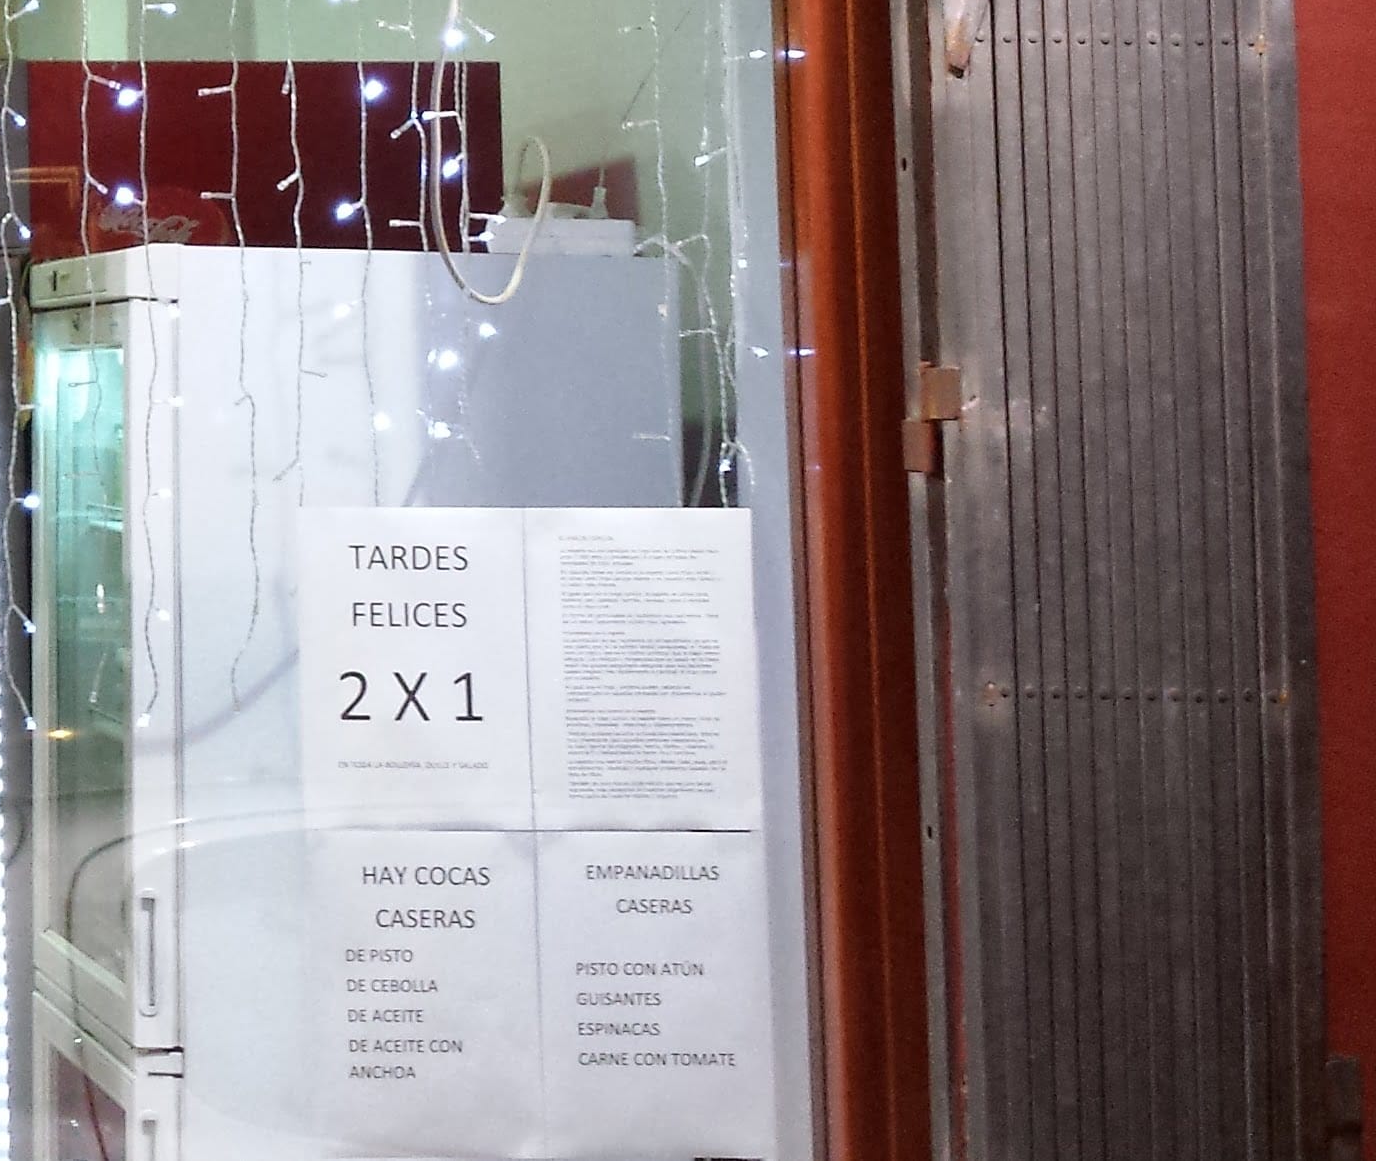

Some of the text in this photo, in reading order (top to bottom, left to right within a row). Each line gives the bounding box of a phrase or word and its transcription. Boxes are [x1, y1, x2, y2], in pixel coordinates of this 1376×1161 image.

[349, 545, 468, 571] TARDES
[352, 602, 467, 627] FELICES
[339, 670, 484, 722] 2 X 1
[362, 866, 490, 887] HAY COCAS
[586, 864, 720, 881] EMPANADILLAS
[616, 899, 693, 915] CASERAS
[376, 909, 476, 929] CASERAS
[345, 949, 414, 963] DE PISTO
[576, 962, 618, 976] PISTO
[623, 962, 656, 976] CON
[346, 979, 438, 992] DE CEBOLLA
[576, 992, 662, 1006] GUISANTES
[348, 1009, 424, 1022] DE ACEITE
[578, 1022, 661, 1036] ESPINACAS
[349, 1039, 463, 1053] DE ACEITE CON
[578, 1052, 737, 1067] CARNE CON TOMATE
[349, 1065, 416, 1079] ANCHOA
